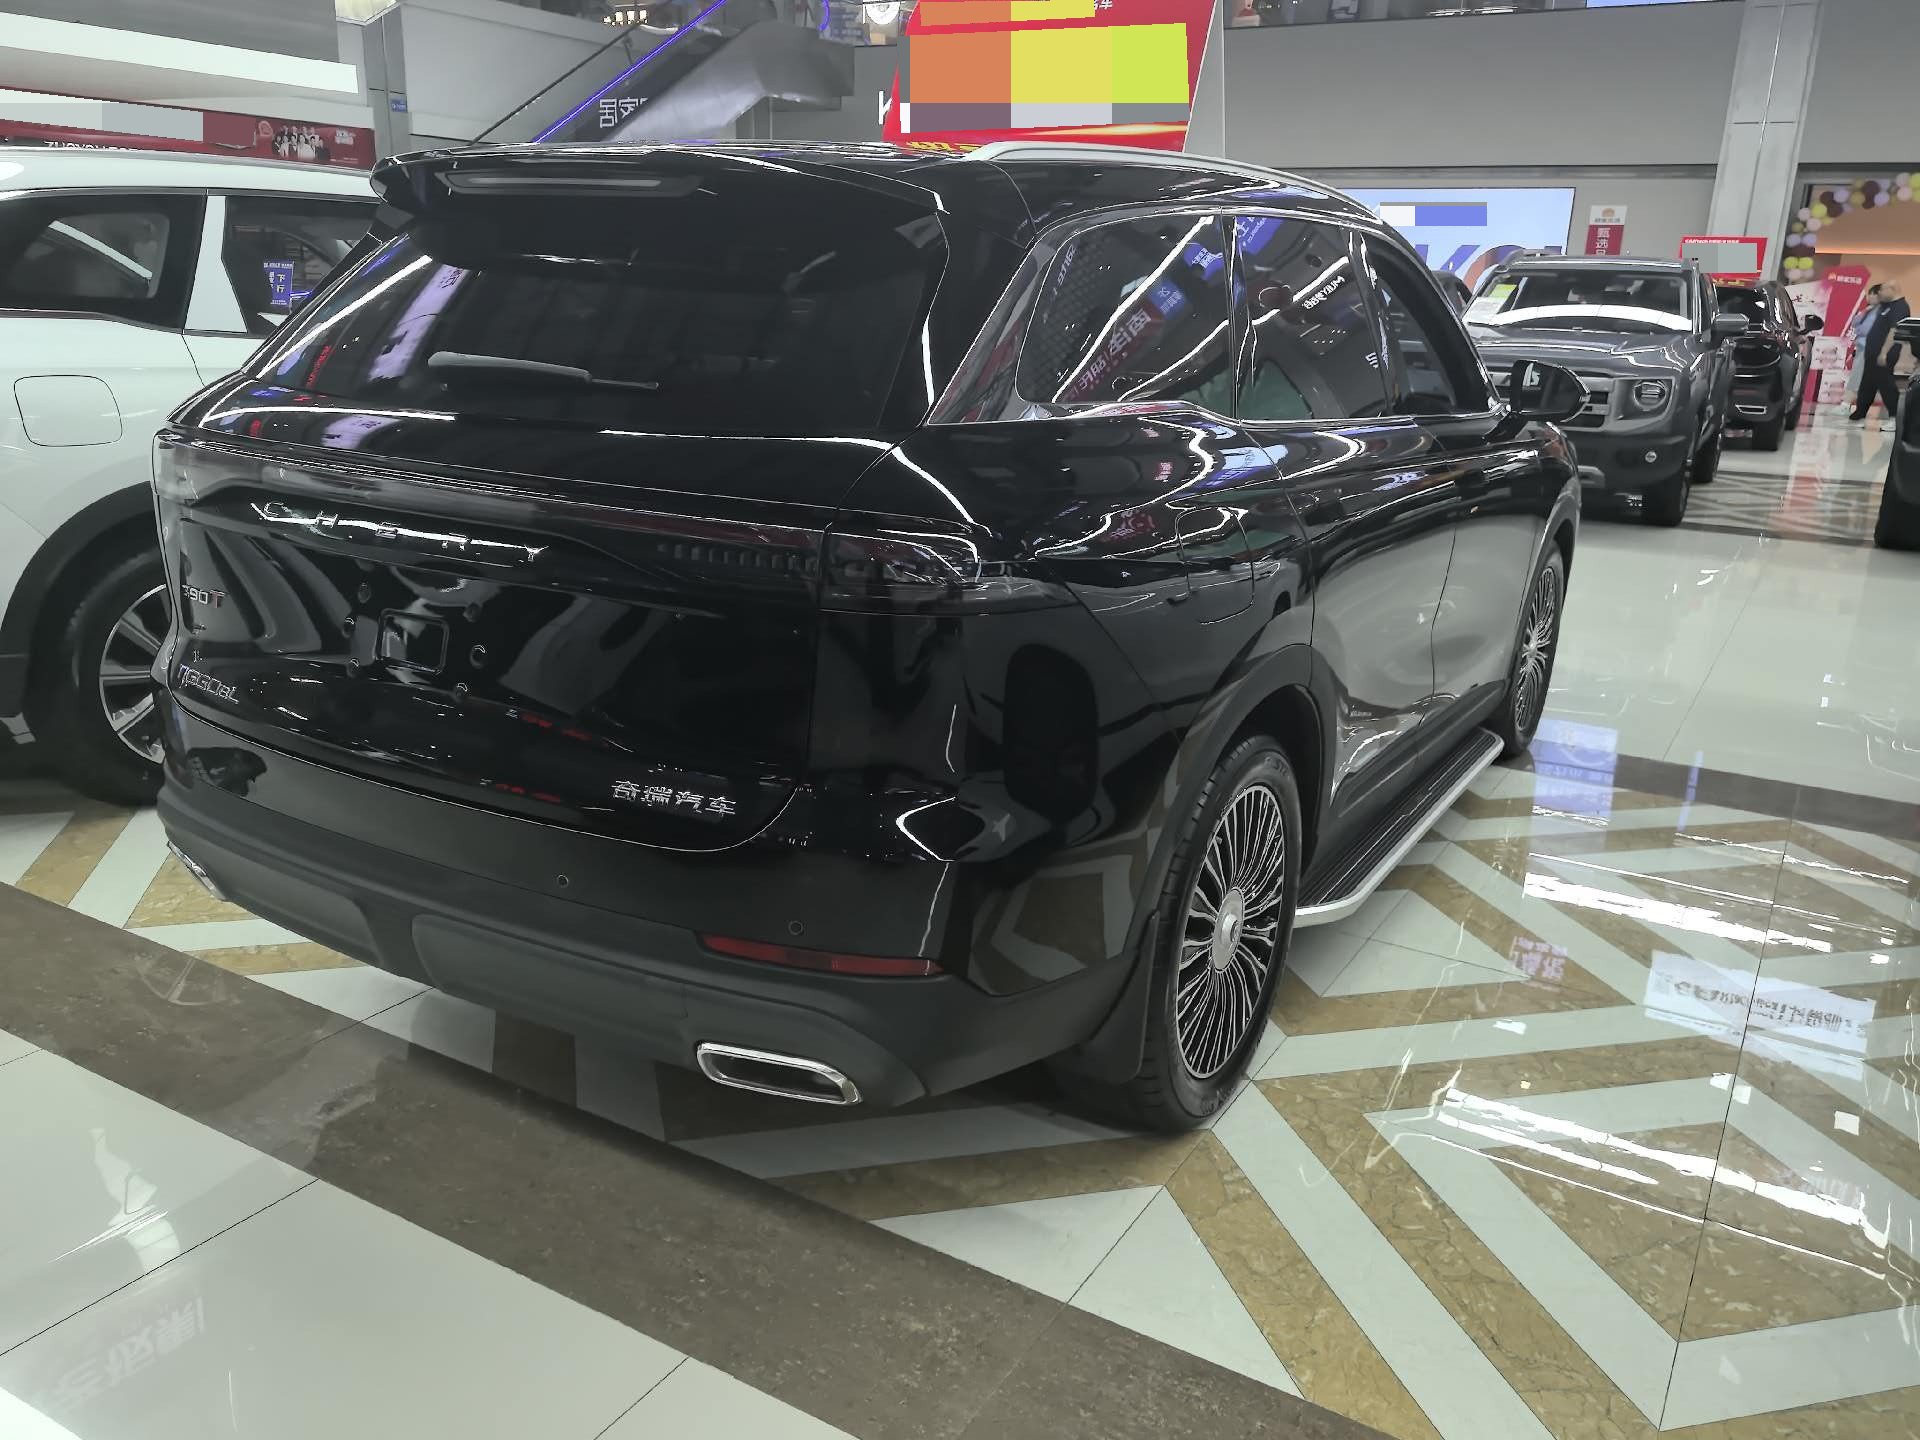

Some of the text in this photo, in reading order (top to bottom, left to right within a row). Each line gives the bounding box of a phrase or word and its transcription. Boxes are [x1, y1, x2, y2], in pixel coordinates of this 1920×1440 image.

[251, 500, 548, 562] CHERY
[611, 780, 737, 817] 奇瑞汽车
